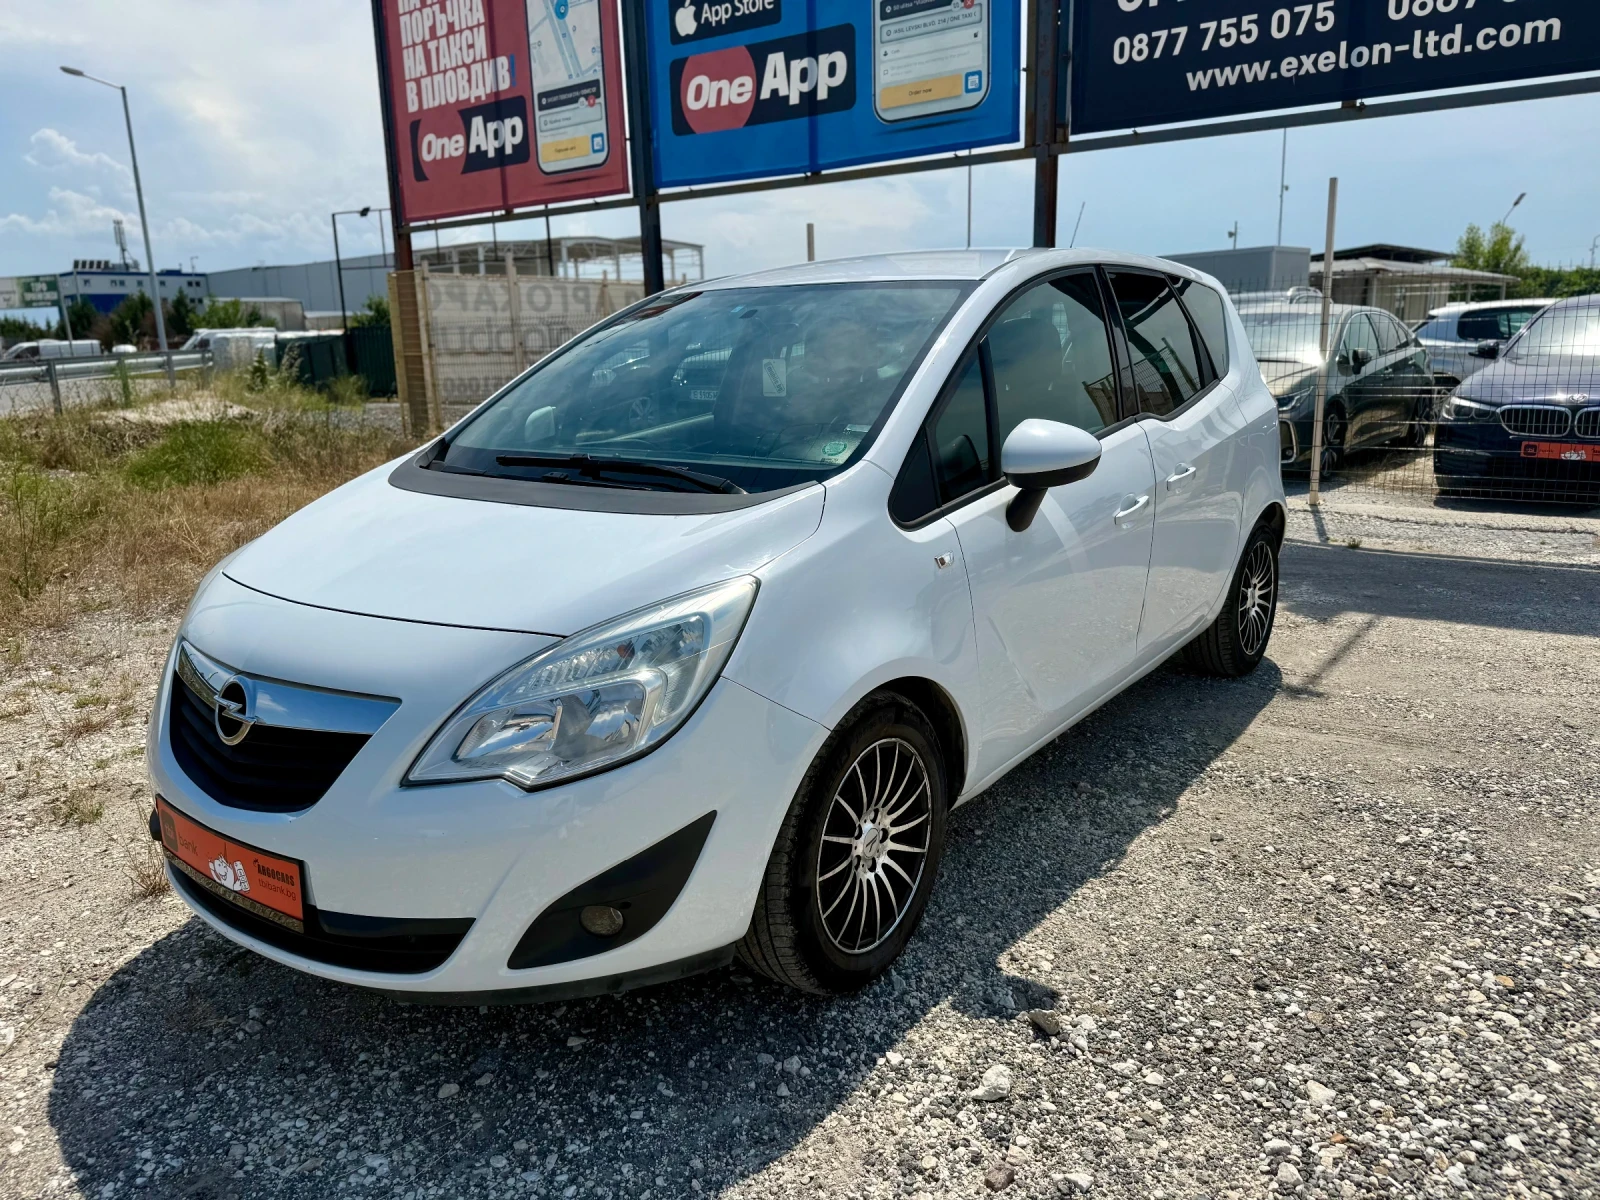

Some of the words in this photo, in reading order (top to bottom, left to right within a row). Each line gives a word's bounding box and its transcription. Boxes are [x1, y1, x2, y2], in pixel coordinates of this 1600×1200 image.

[399, 0, 485, 48] ПОРЪЧКА
[701, 3, 732, 27] App
[734, 0, 774, 16] Store
[905, 23, 922, 32] LEVSKI
[950, 15, 961, 23] ONE
[1113, 26, 1188, 65] 0877
[1200, 14, 1259, 52] 755
[1270, 0, 1335, 39] 075
[403, 44, 427, 81] НА
[427, 25, 487, 74] ТАКСИ
[1186, 16, 1562, 92] www.exelon-ltd.com
[406, 81, 419, 113] В
[421, 54, 516, 109] ПЛОВДИВ!
[687, 75, 752, 110] One
[760, 51, 847, 105] App
[421, 133, 464, 162] One
[468, 115, 524, 158] App
[257, 865, 295, 887] ARGOCARS
[258, 878, 297, 901] tbibank.bg
